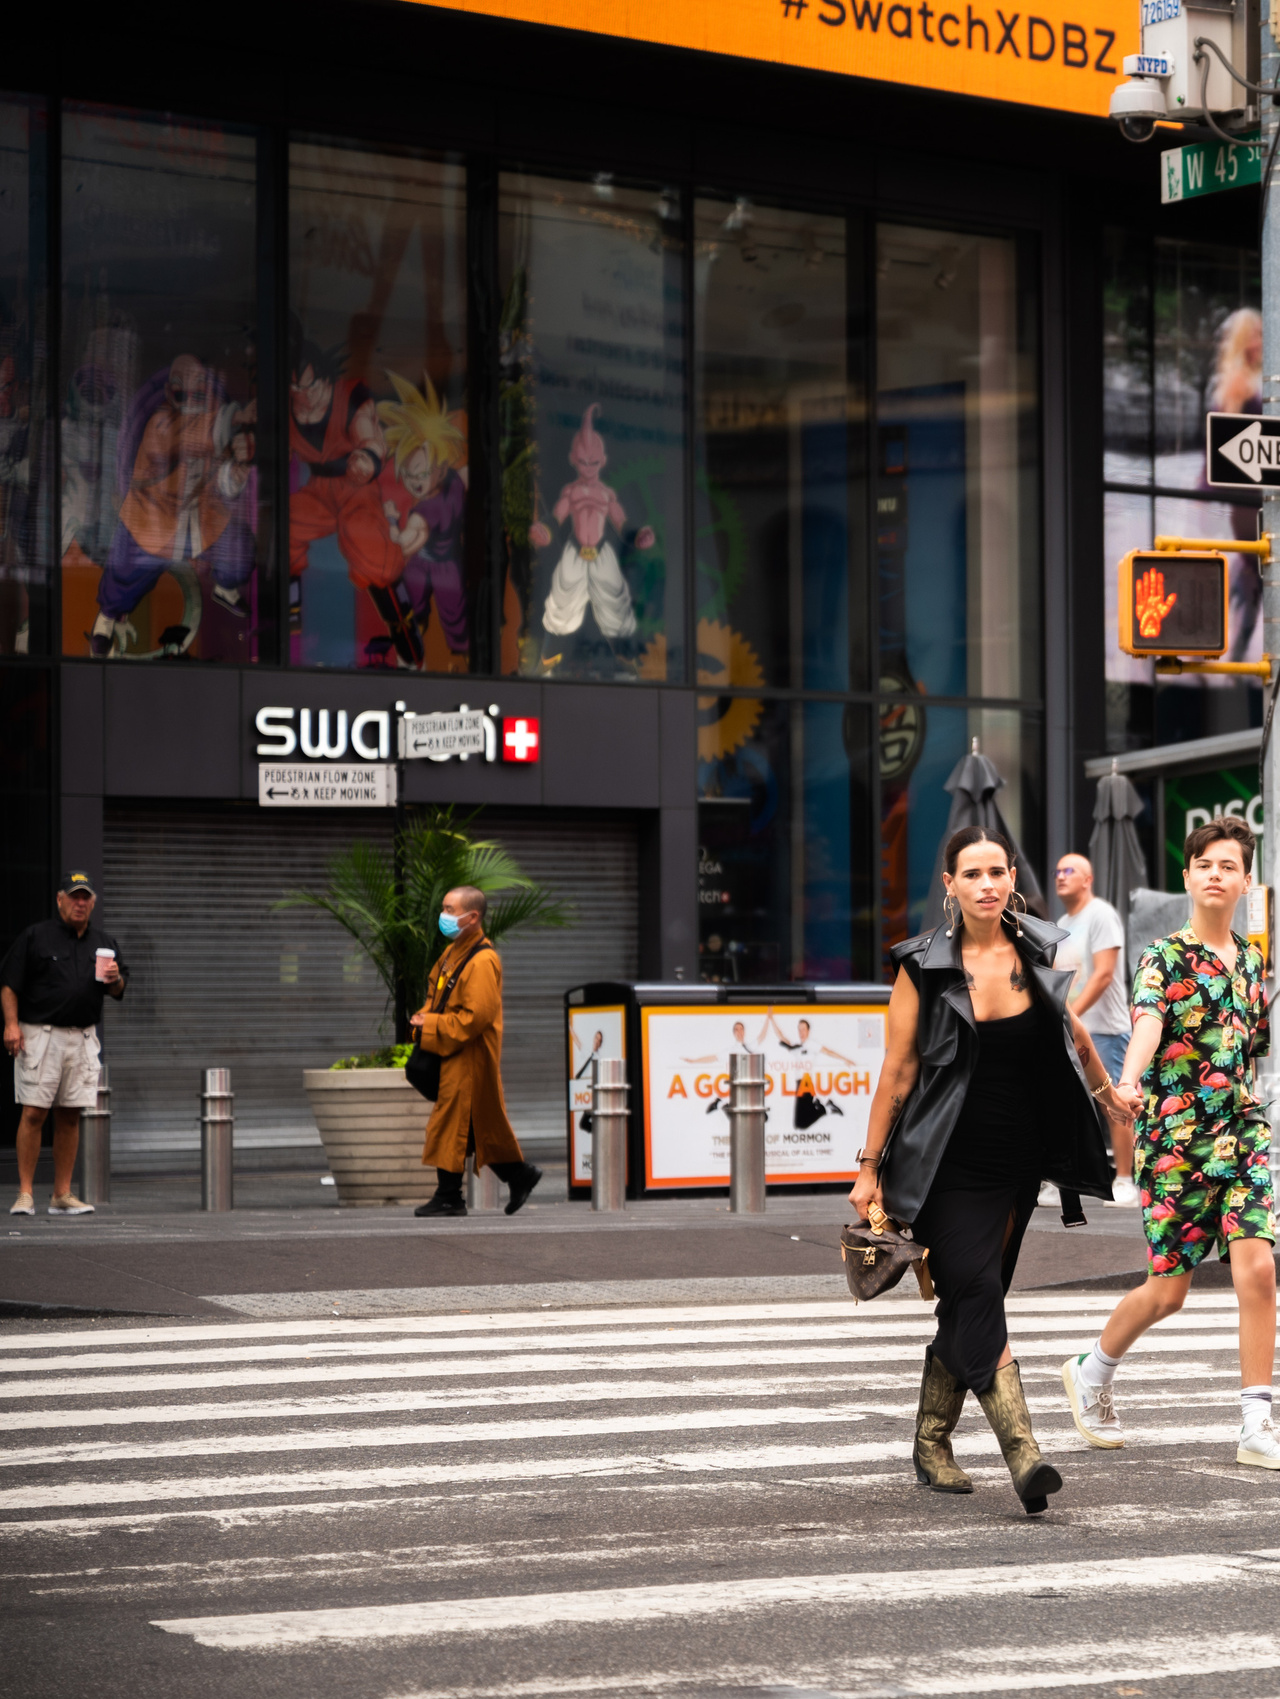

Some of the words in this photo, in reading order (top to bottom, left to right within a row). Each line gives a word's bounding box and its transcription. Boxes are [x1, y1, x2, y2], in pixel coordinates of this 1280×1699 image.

[1136, 56, 1168, 74] NYPD
[1187, 150, 1205, 190] W
[1215, 143, 1238, 183] 45
[412, 719, 447, 735] PEDESTRIAN
[447, 718, 463, 732] FLOW
[465, 716, 480, 730] ZONE
[443, 736, 456, 749] KEEP
[459, 733, 480, 748] MOVING
[265, 769, 321, 783] PEDESTRIAN
[323, 769, 348, 783] FLOW
[351, 769, 376, 783] ZONE
[313, 788, 337, 800] KEEP
[340, 788, 376, 800] MOVING
[768, 1062, 789, 1071] YOU
[791, 1061, 813, 1071] HAD
[667, 1074, 688, 1099] A
[694, 1073, 775, 1098] GOD
[781, 1072, 870, 1097] LAUGH
[783, 1133, 831, 1144] MORMON
